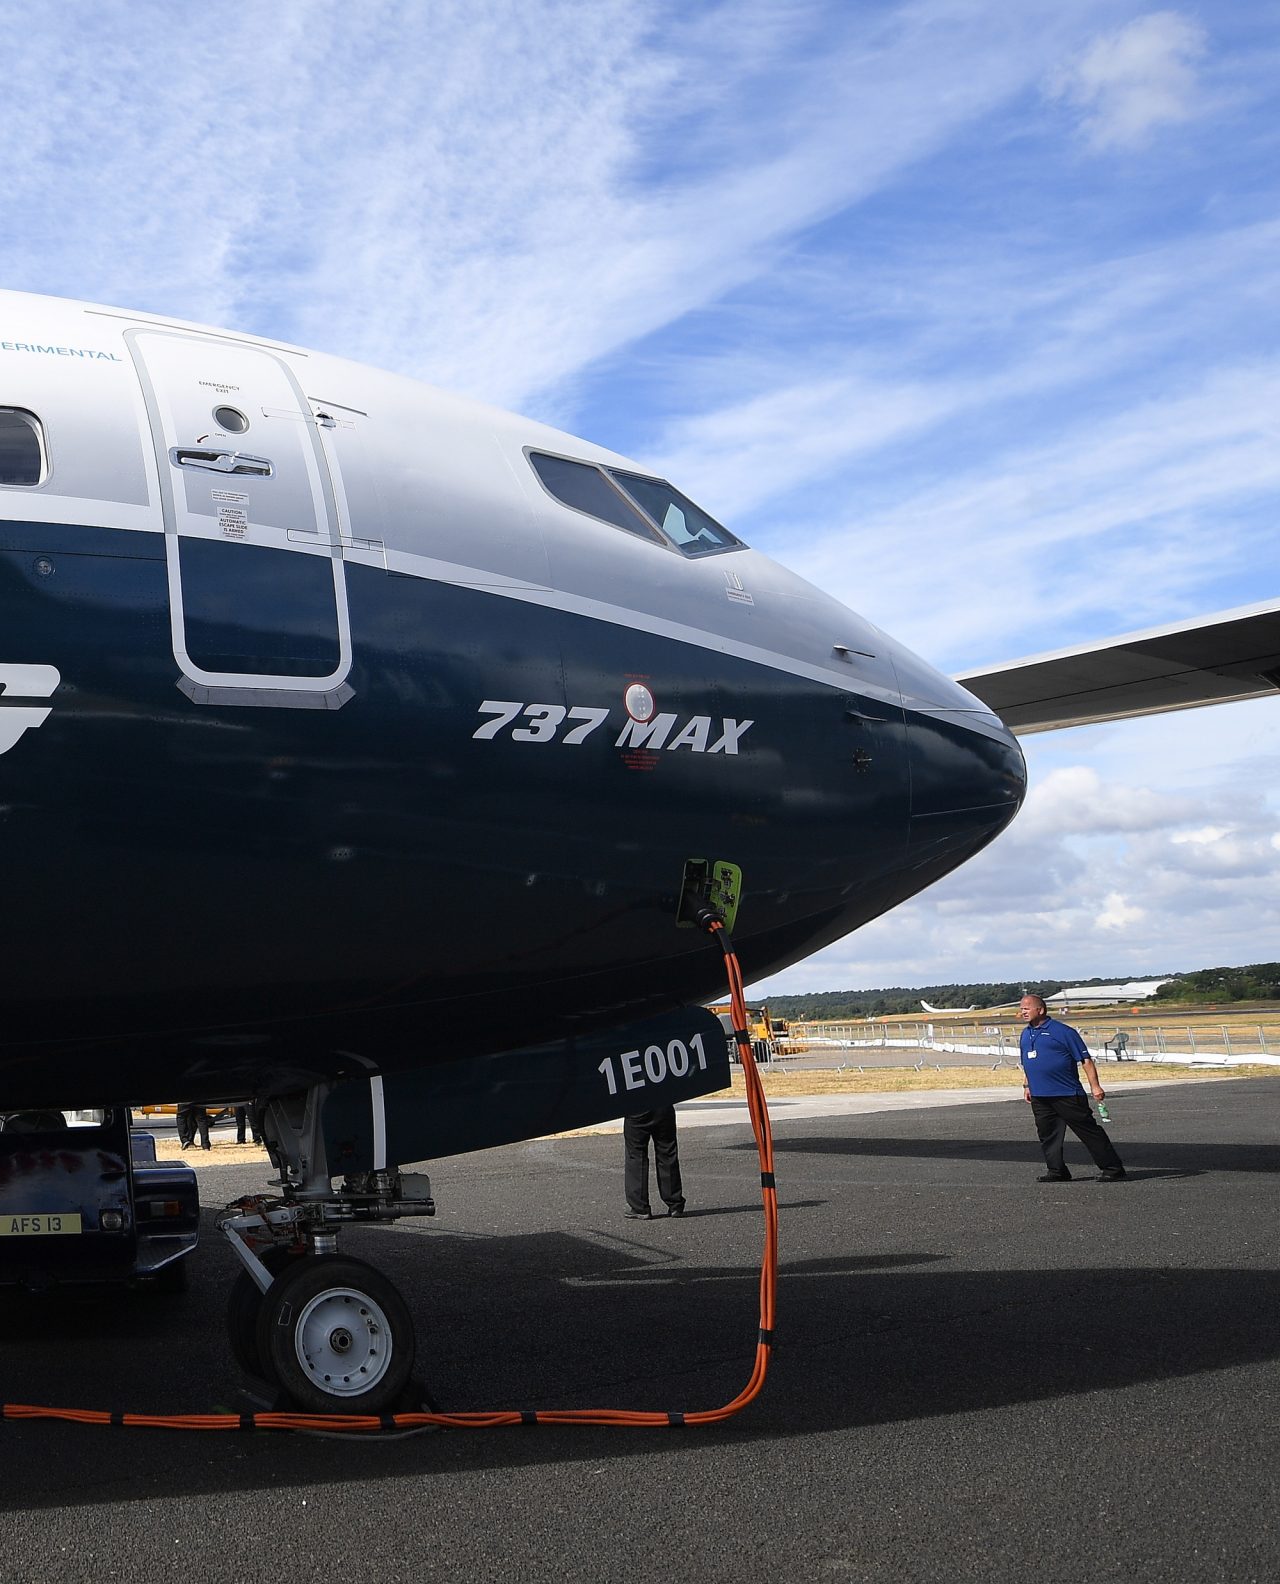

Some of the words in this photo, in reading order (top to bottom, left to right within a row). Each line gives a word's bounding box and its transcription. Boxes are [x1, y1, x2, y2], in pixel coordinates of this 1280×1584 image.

[198, 381, 240, 391] EMERGENCY
[220, 518, 247, 526] AUTOMATIC
[472, 700, 611, 745] 737
[614, 712, 755, 756] MAX
[598, 1033, 708, 1095] 1E001
[10, 1217, 41, 1233] AFS
[47, 1217, 62, 1232] 13
